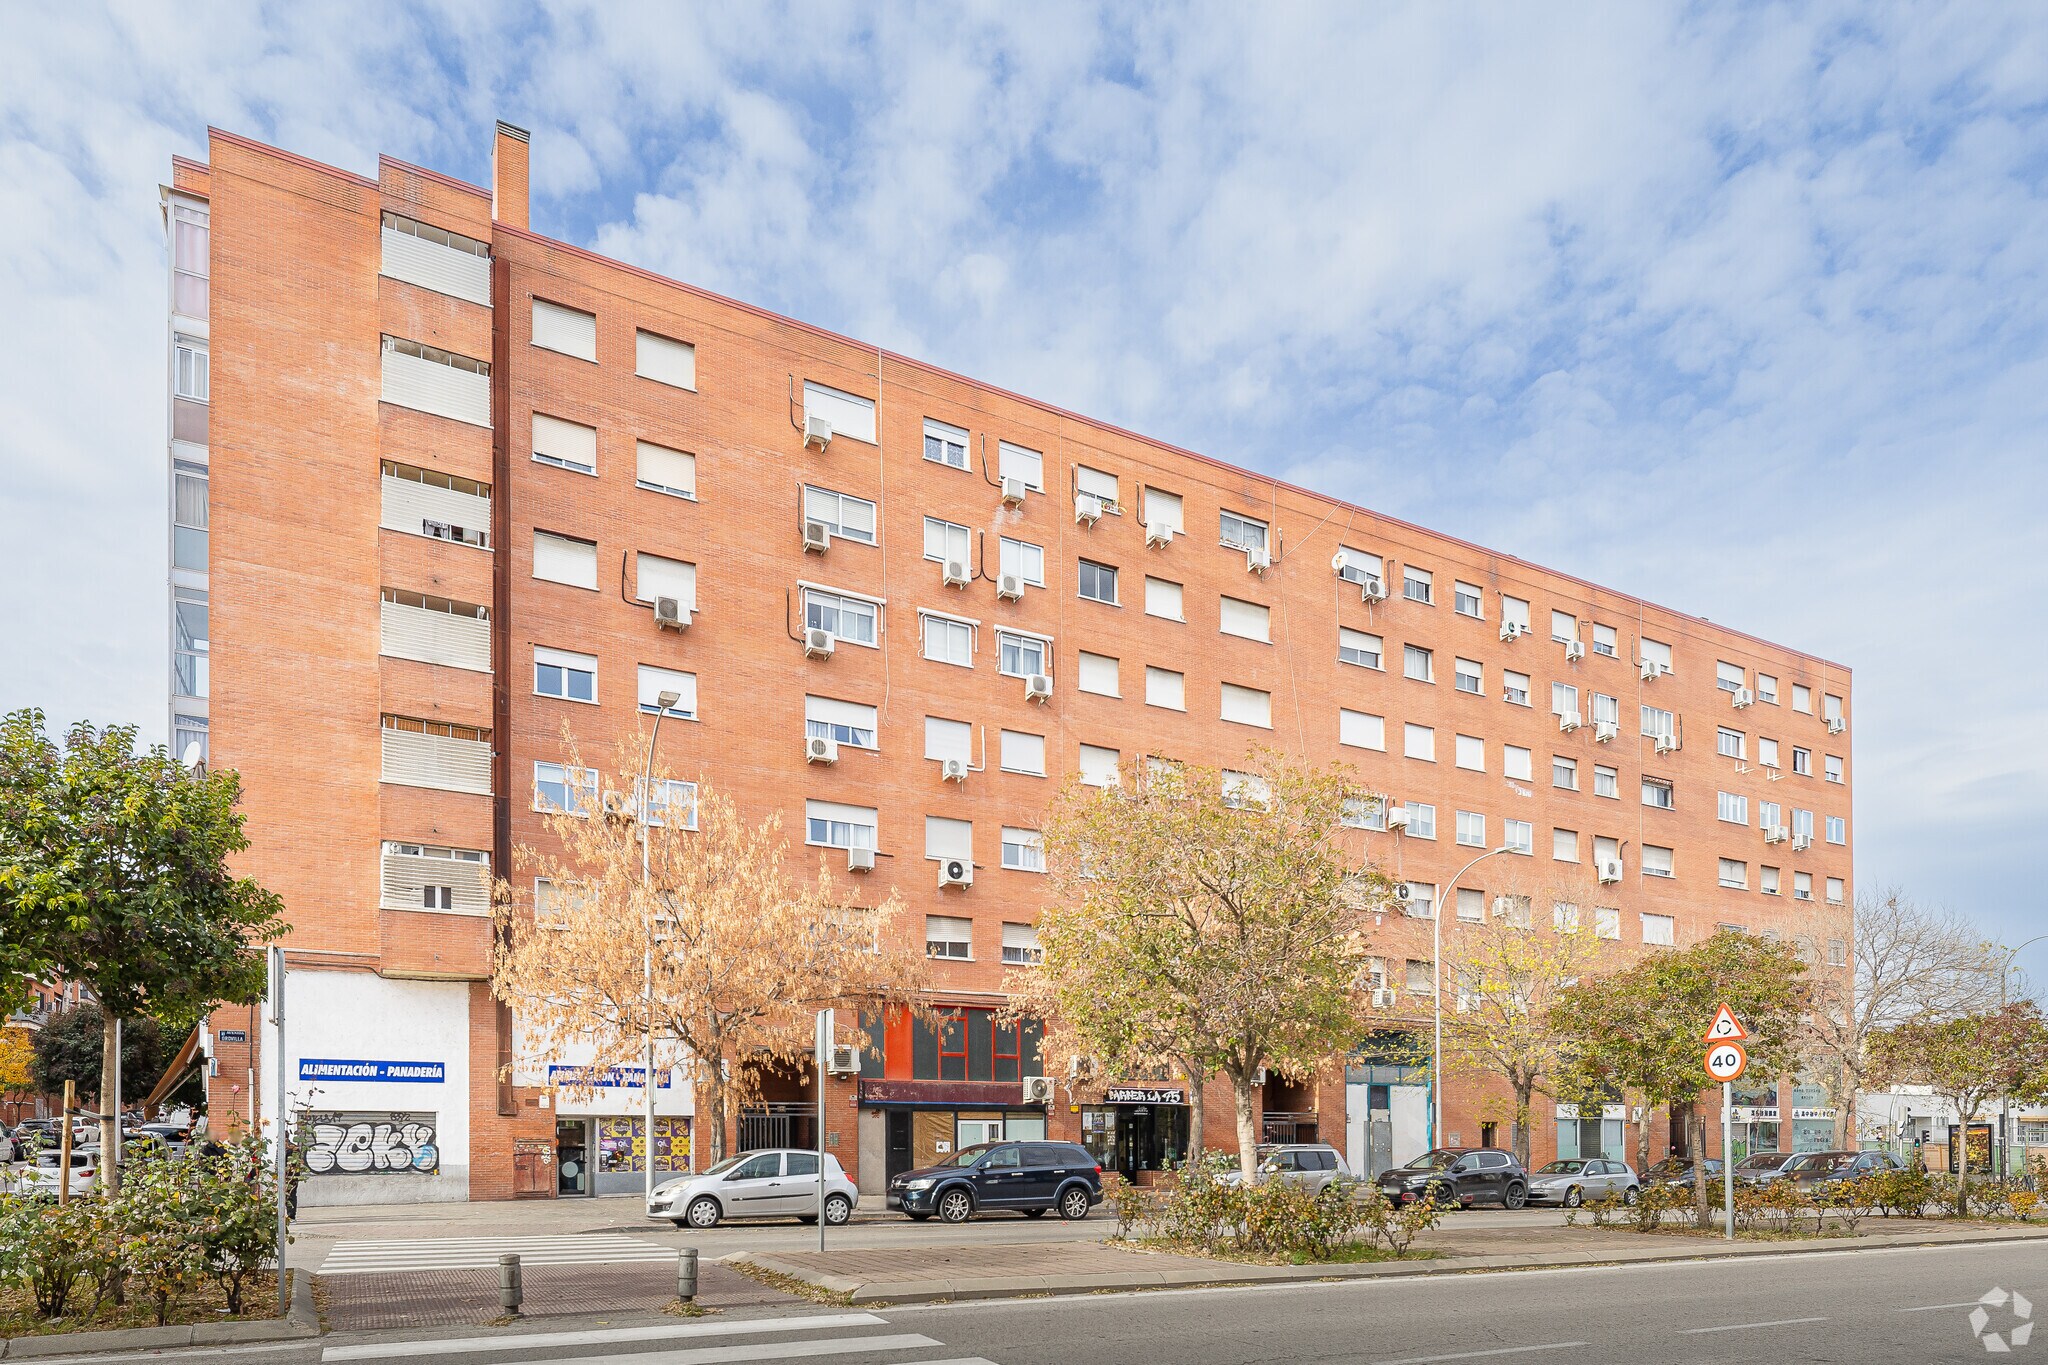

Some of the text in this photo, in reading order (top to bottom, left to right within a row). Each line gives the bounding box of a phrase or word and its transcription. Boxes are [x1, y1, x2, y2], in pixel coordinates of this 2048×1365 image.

[1712, 1054, 1736, 1068] 40
[300, 1063, 378, 1077] ALIMENTACIÓN
[386, 1064, 443, 1078] PANADERÍA
